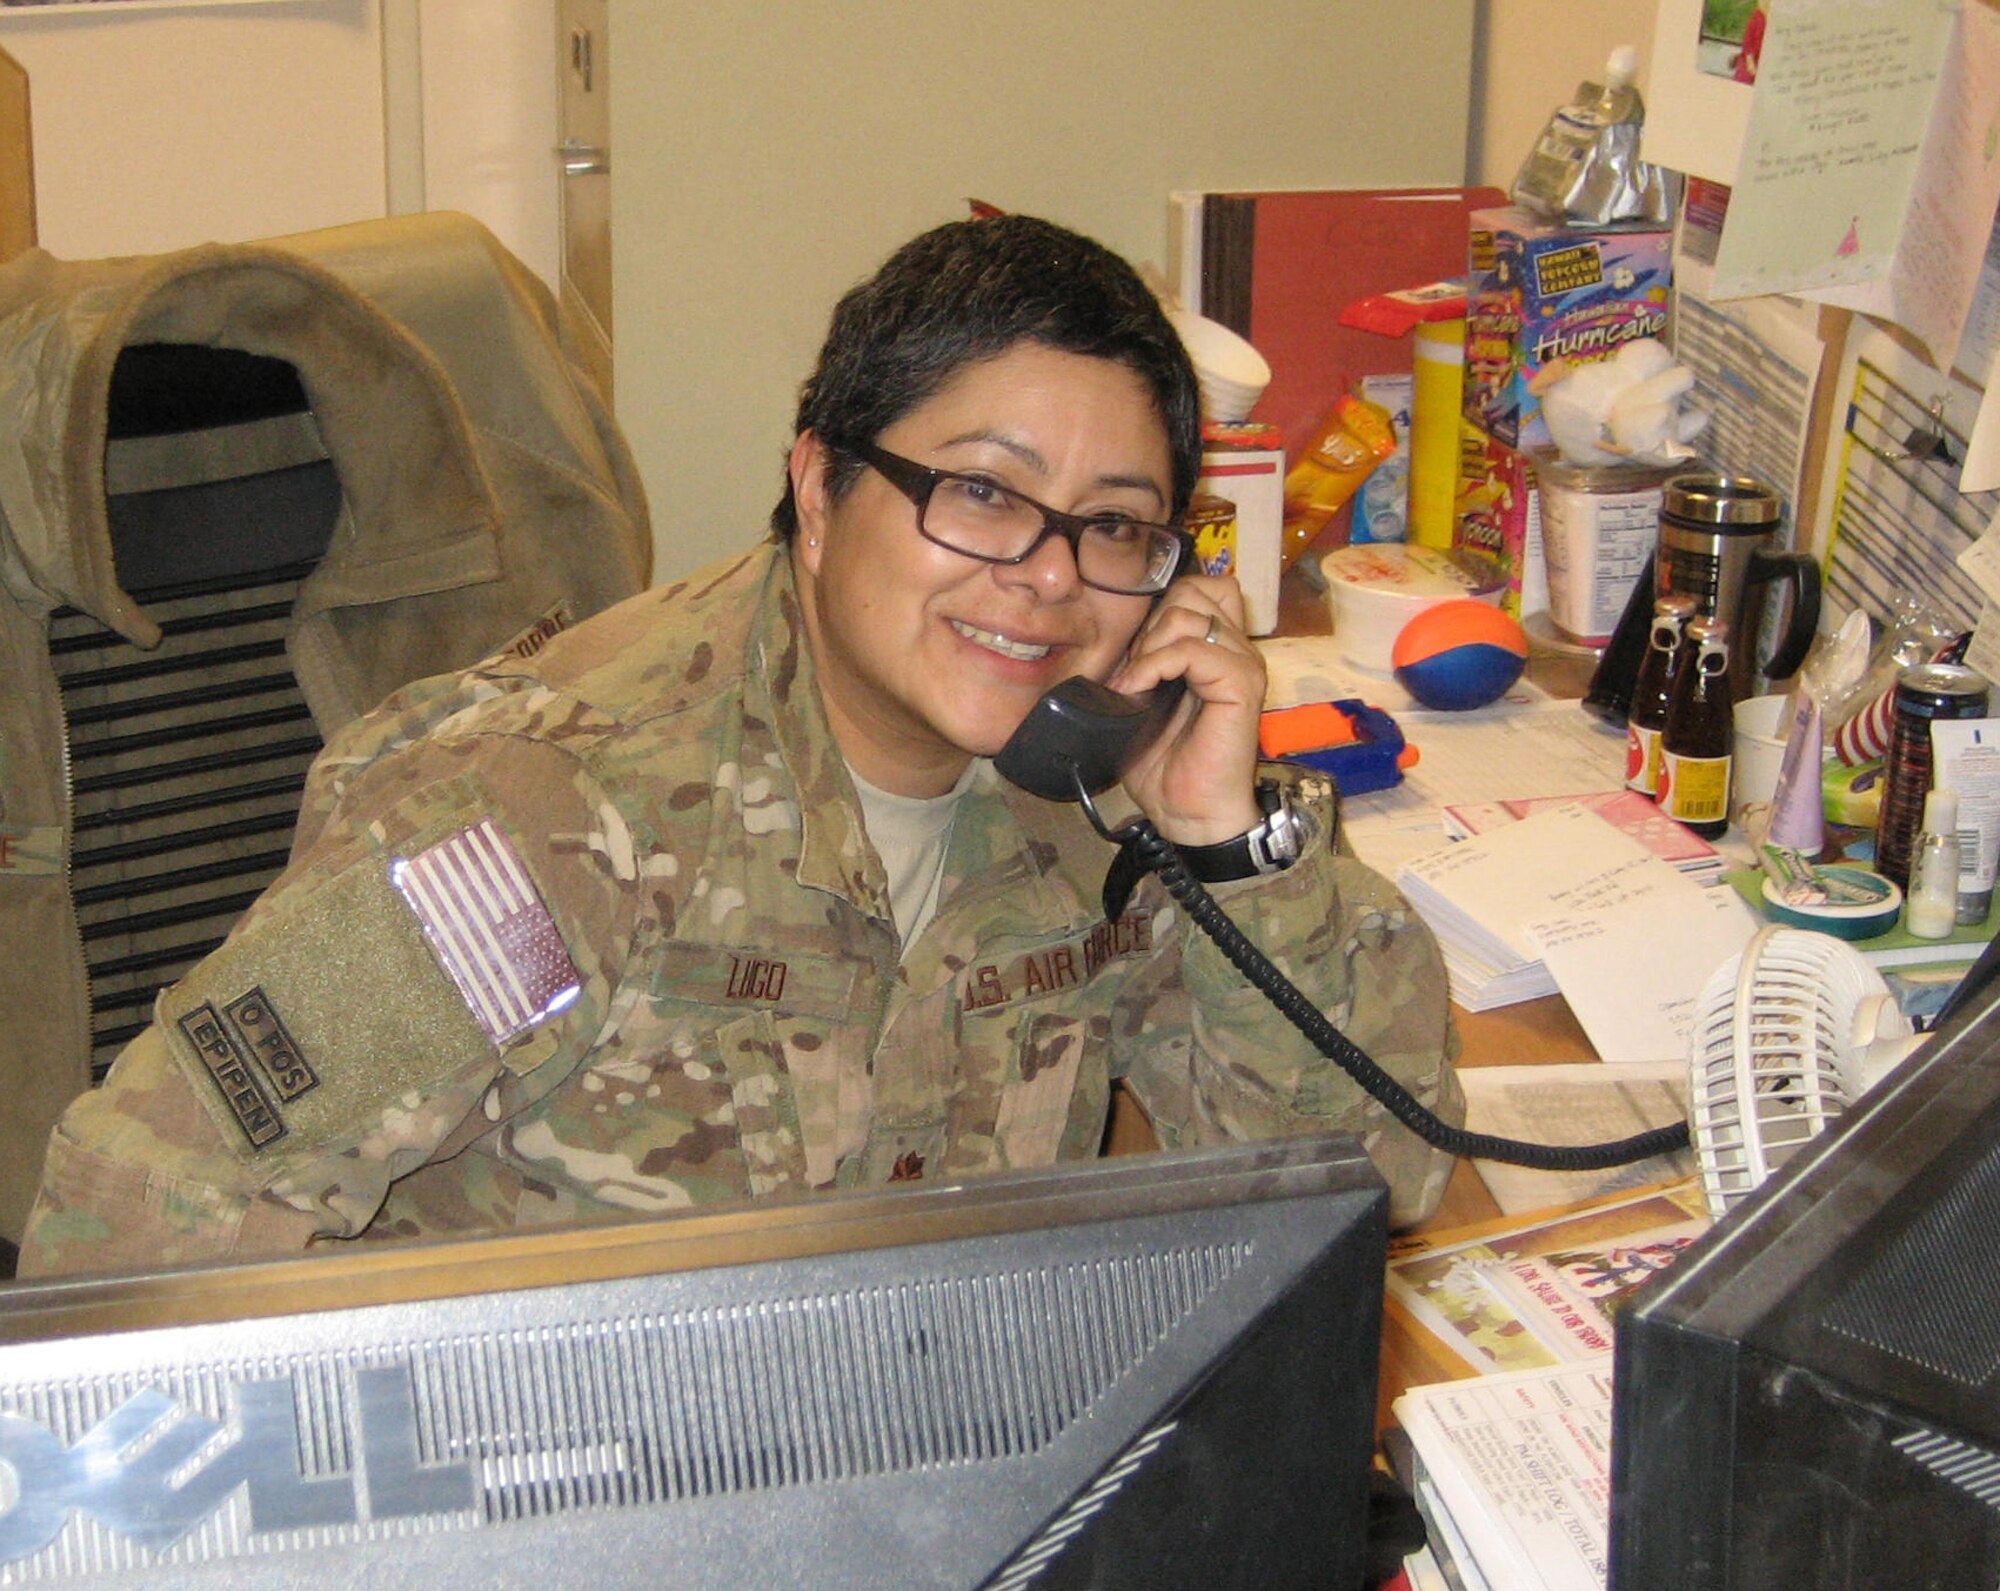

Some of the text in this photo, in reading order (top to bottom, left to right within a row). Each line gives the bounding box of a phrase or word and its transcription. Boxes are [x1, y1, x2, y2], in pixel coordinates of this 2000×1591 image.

[1532, 312, 1666, 364] Hurricane
[726, 956, 787, 1000] LUGO
[1025, 946, 1078, 996] AIR
[194, 1021, 272, 1134] EPIPEN
[256, 1030, 305, 1090] POS
[1564, 1518, 1596, 1554] TOTAL
